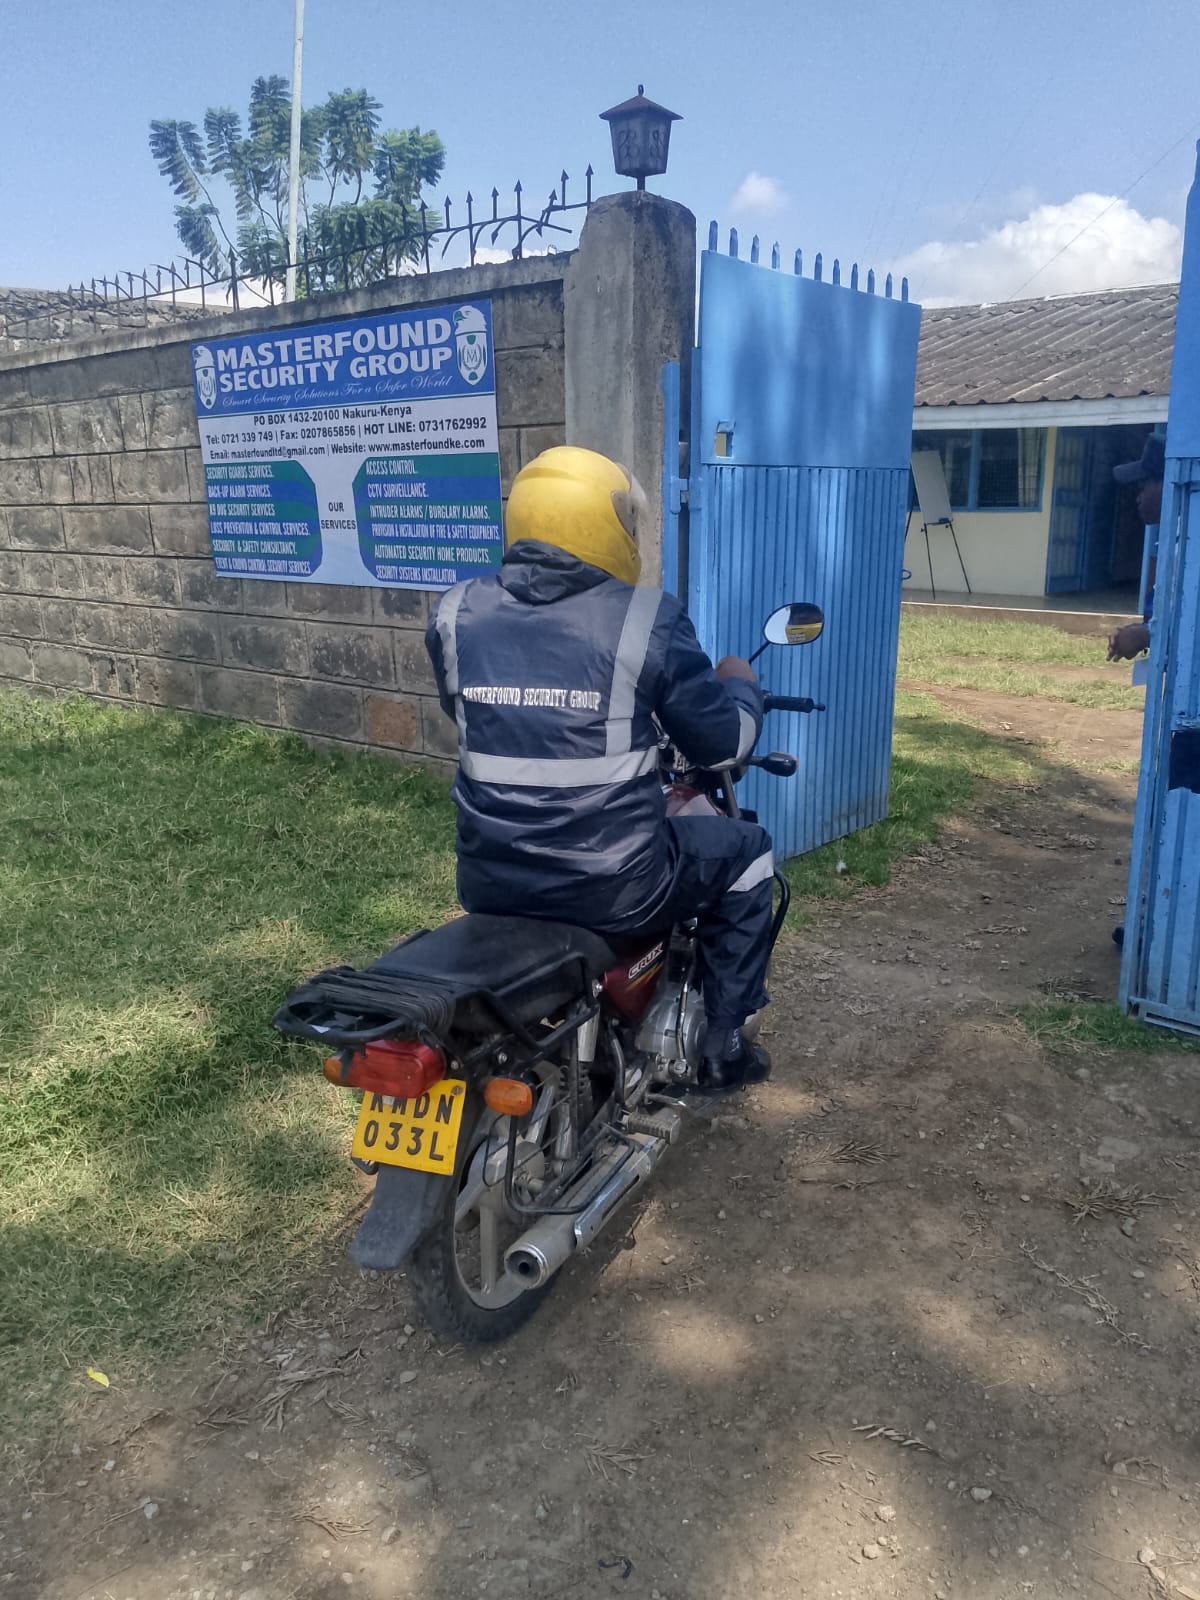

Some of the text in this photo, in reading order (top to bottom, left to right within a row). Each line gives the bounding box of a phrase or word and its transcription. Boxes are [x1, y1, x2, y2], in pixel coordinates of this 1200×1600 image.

[217, 318, 451, 371] MASTERFOUND
[219, 347, 452, 393] SECURITY GROUP
[222, 396, 251, 408] Smart
[253, 391, 291, 406] Security
[294, 387, 339, 402] Solutions
[340, 382, 364, 396] For
[375, 381, 406, 394] Safer
[411, 375, 453, 389] World
[254, 405, 412, 426] PO BOX 1432-20100 Nakuru-Kenya
[206, 435, 219, 446] Tel:
[221, 433, 239, 444] 0721
[241, 432, 256, 443] 339
[258, 430, 273, 441] 749
[280, 429, 298, 441] Fax:
[300, 425, 356, 439] 0207865856
[364, 423, 385, 435] HOT
[388, 421, 416, 434] LINE:
[419, 417, 487, 432] 0731762992
[210, 449, 229, 460] Email:
[331, 442, 366, 455] Website:
[368, 437, 485, 452] www.masterfoundke.com
[206, 467, 228, 479] SECURITY
[366, 460, 388, 475] ACCESS
[367, 483, 382, 498] CCTV
[227, 503, 250, 516] SECURITY
[328, 502, 344, 512] OUR
[370, 505, 399, 518] INTRUDER
[399, 505, 423, 519] ALARMS
[428, 505, 460, 519] BURGLARY
[320, 519, 356, 529] SERVICES
[374, 544, 407, 559] AUTOMATED
[408, 545, 435, 561] SECURITY
[437, 546, 455, 562] HOME
[523, 688, 568, 708] SECURITY
[570, 690, 601, 712] GROUP
[628, 941, 664, 979] CRUX
[369, 1091, 454, 1124] KMDN
[363, 1119, 444, 1161] 033L
